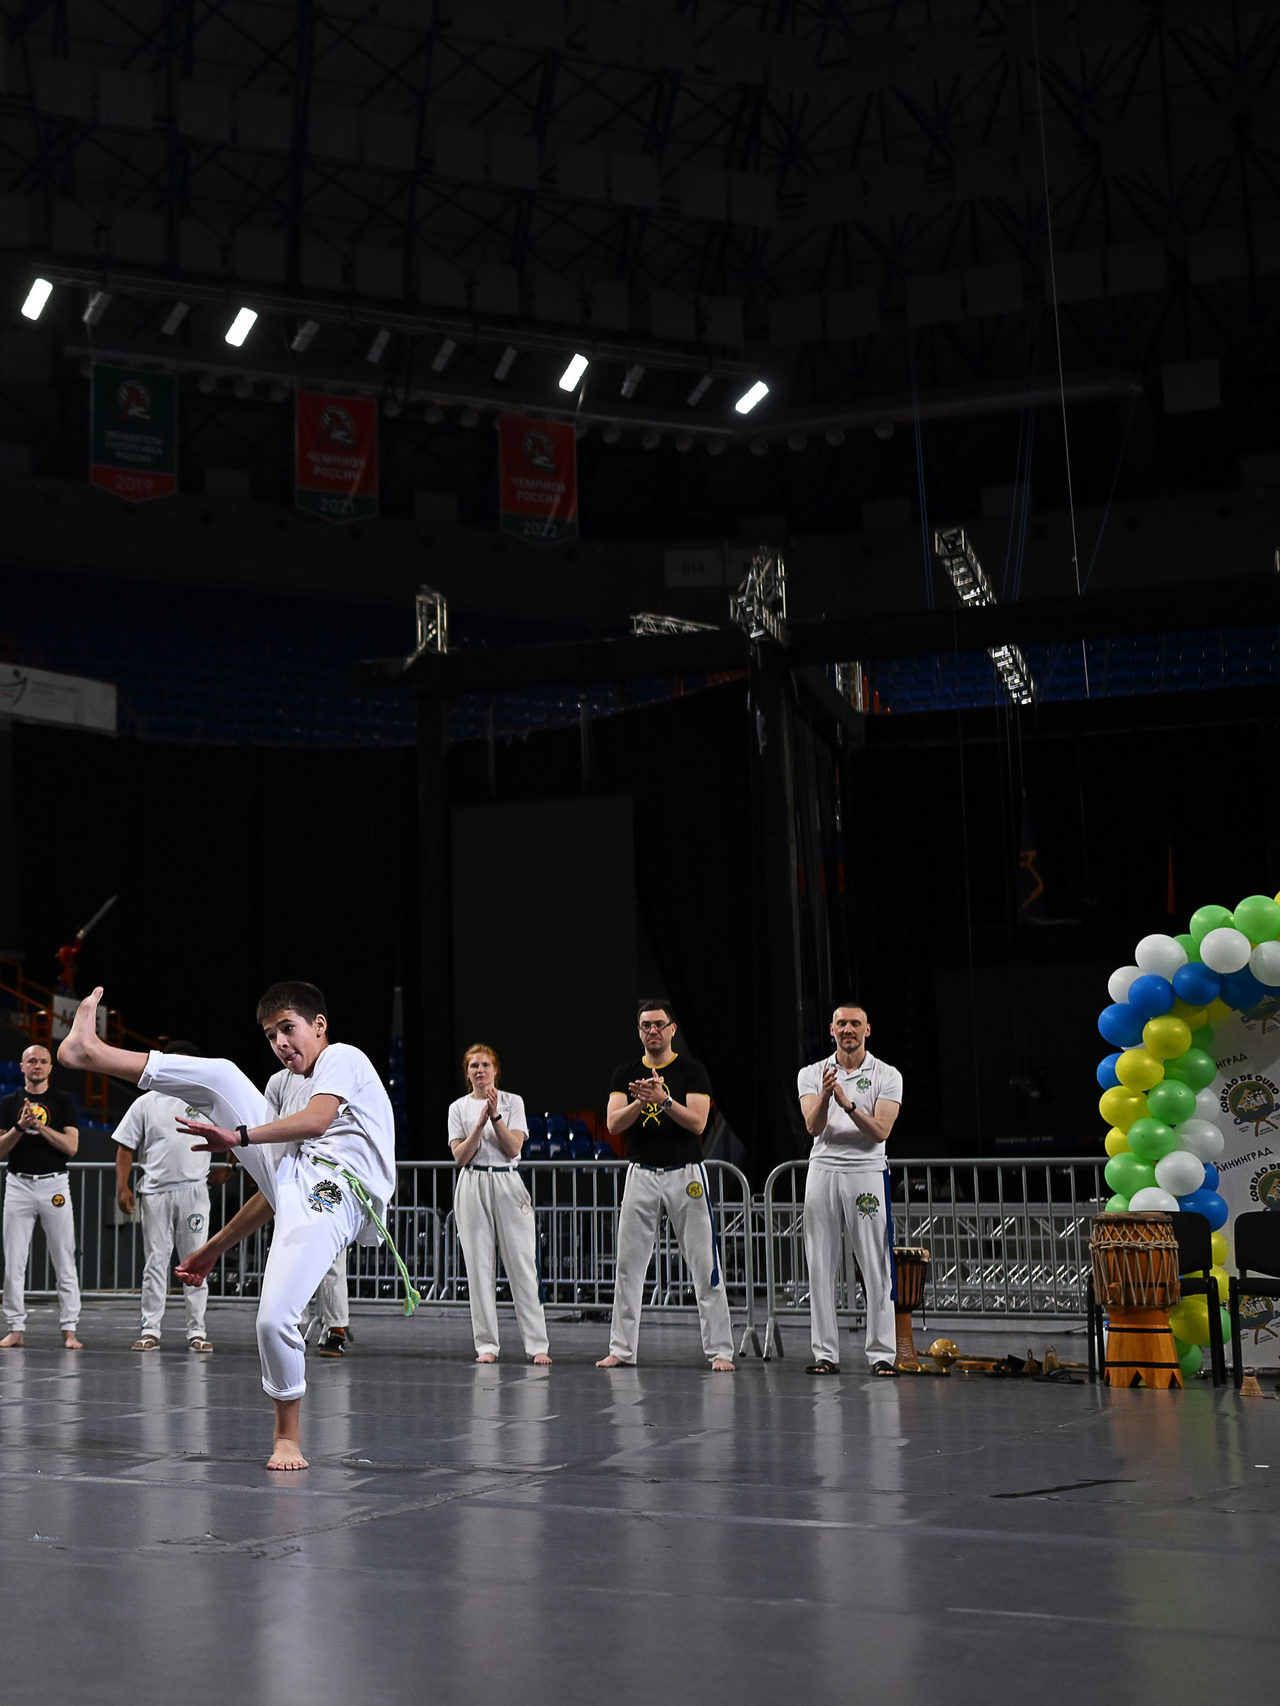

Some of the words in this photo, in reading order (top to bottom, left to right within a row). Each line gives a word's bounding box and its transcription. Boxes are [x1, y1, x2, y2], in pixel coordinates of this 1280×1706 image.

[307, 451, 366, 469] ЧЕМПИОН
[312, 465, 361, 480] РОССИИ
[115, 475, 154, 491] 2019
[510, 476, 566, 494] ЧЕМПИОН
[319, 497, 355, 515] 2021
[516, 490, 561, 506] РОССИИ
[1215, 1052, 1248, 1070] НГРАД
[1220, 1077, 1239, 1113] CORDÃO
[1239, 1073, 1253, 1082] DE
[1255, 1074, 1280, 1095] OURO
[1216, 1147, 1274, 1173] ЛИНИНГРАД
[1250, 1166, 1268, 1202] CORDÃO
